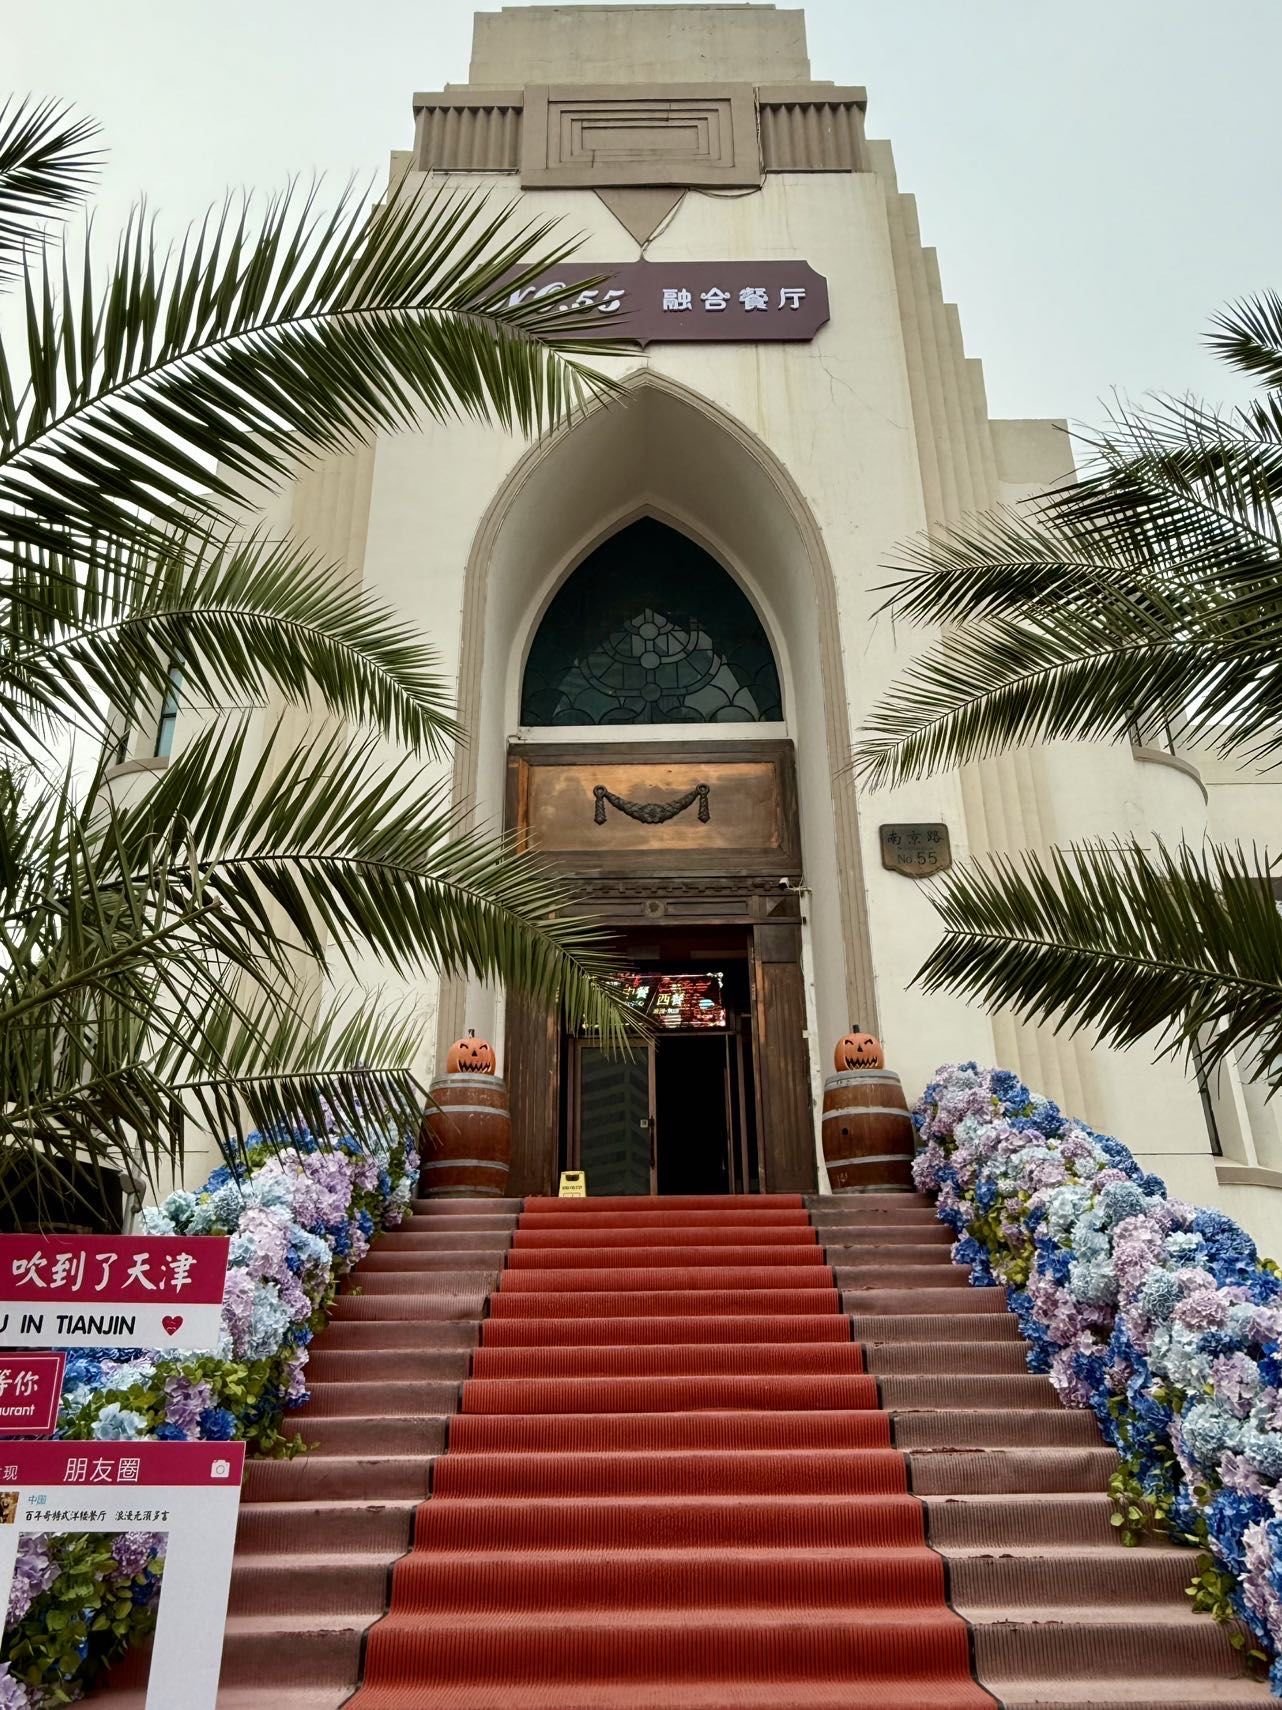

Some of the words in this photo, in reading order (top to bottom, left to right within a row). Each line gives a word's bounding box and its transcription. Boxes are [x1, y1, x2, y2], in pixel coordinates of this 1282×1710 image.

[662, 287, 806, 311] 融合餐厅
[887, 829, 944, 845] 南京路
[897, 851, 938, 865] No.55
[656, 993, 685, 1006] 西餐
[12, 1251, 197, 1293] 吹到了天津
[20, 1314, 44, 1334] IN
[56, 1315, 136, 1335] TIANJIN
[0, 1404, 35, 1416] urant
[63, 1457, 140, 1482] 朋友圈
